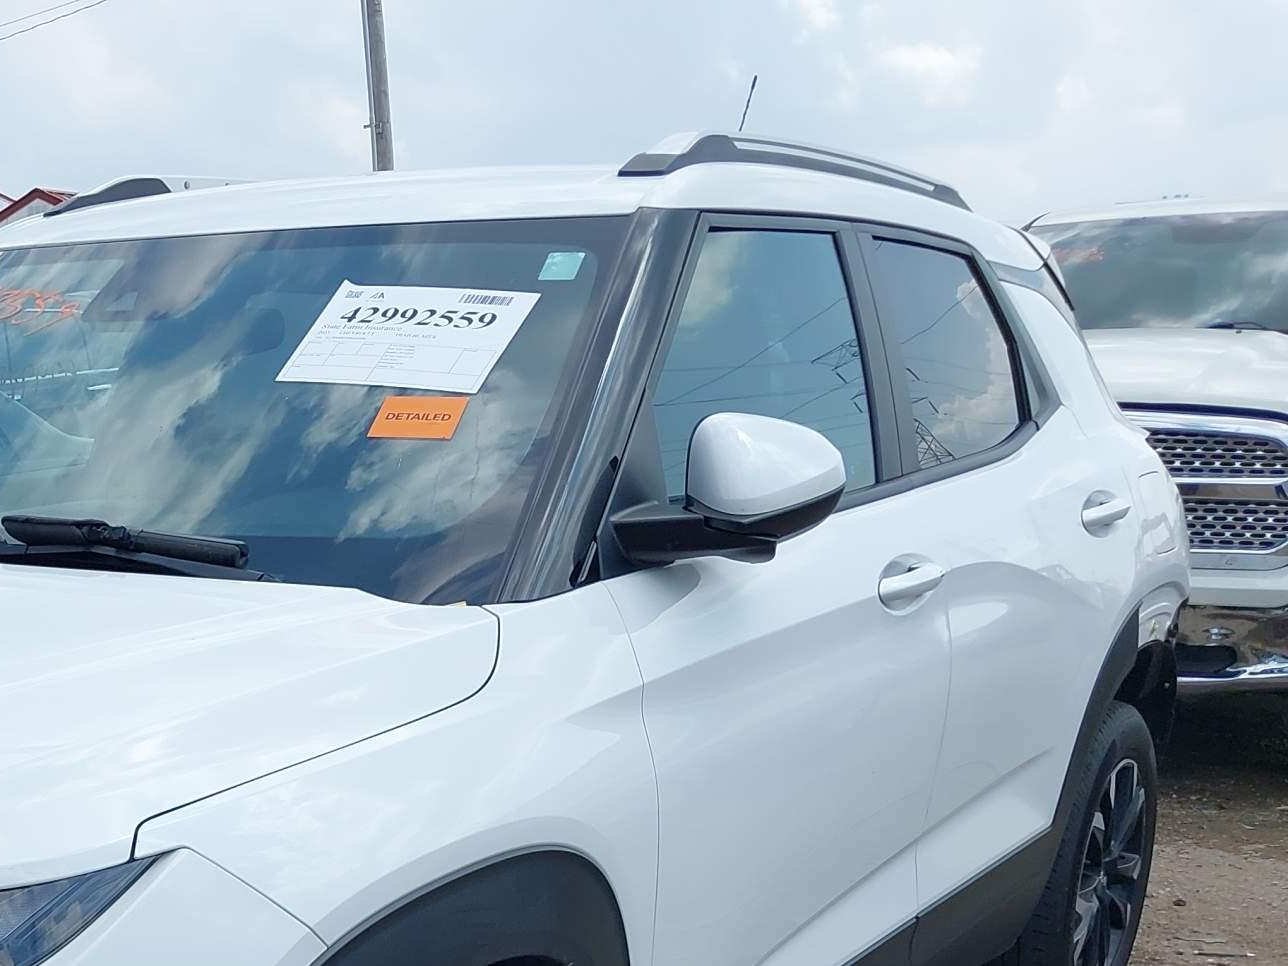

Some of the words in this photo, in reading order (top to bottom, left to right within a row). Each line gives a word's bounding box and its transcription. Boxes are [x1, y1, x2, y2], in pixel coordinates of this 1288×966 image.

[339, 306, 498, 330] 42992559
[364, 324, 403, 333] Insurance
[385, 412, 452, 422] DETAILED
